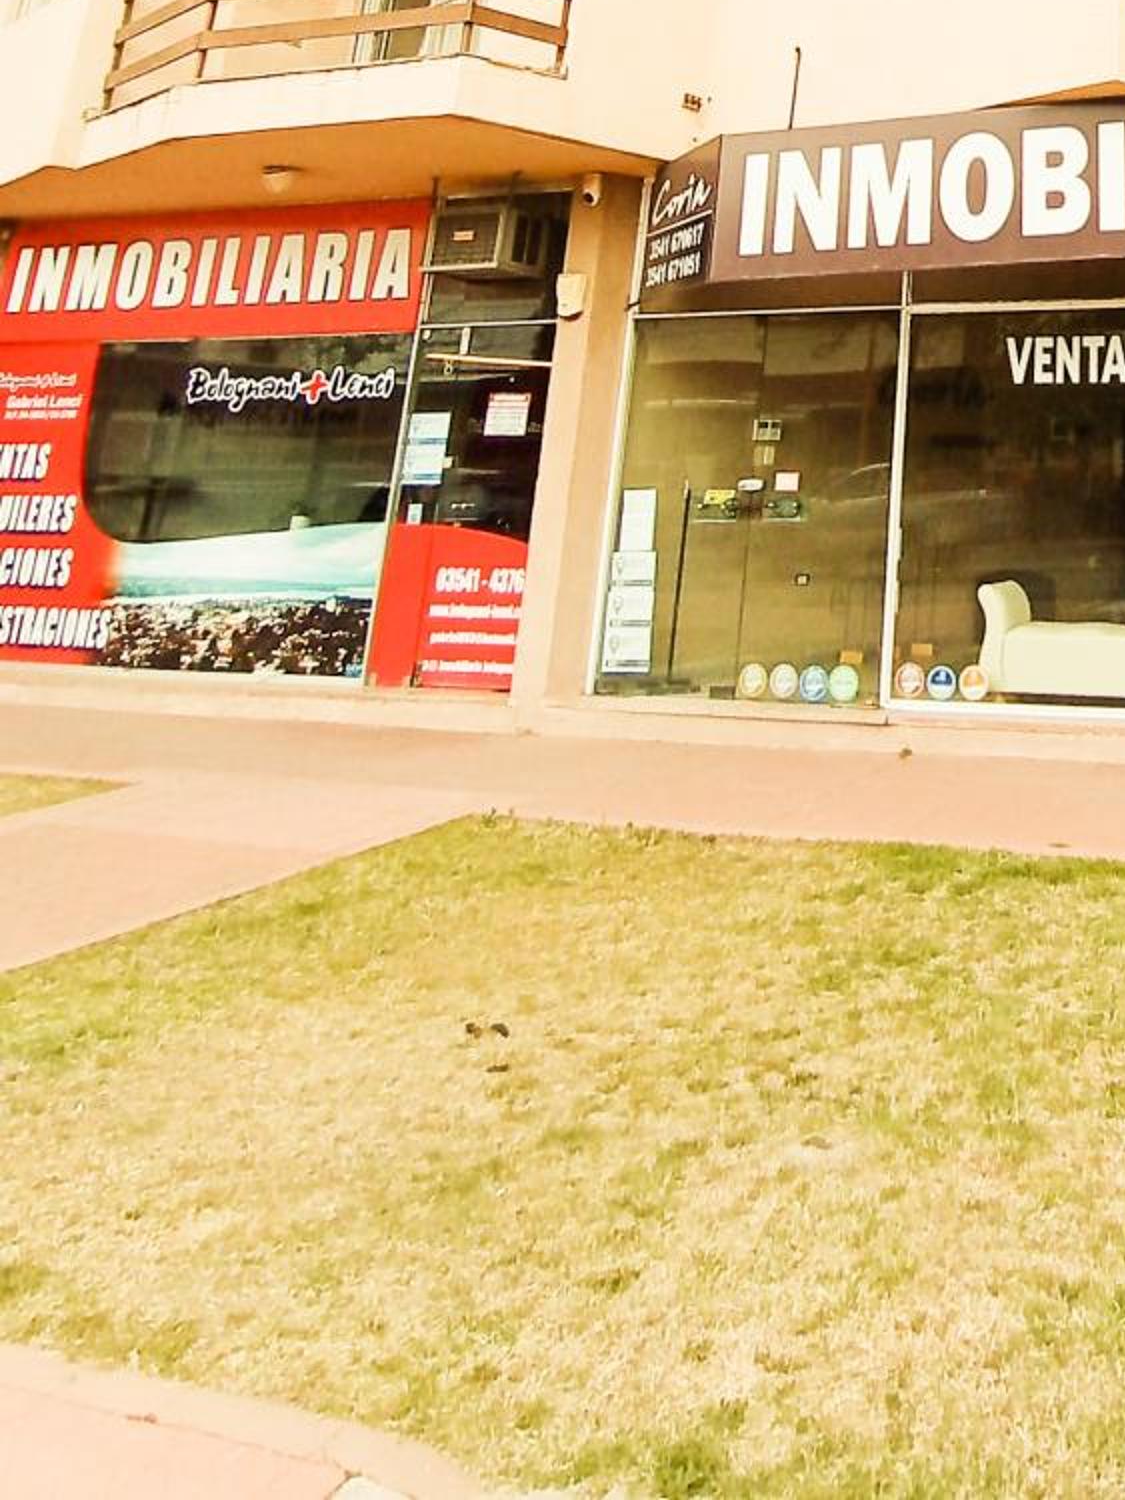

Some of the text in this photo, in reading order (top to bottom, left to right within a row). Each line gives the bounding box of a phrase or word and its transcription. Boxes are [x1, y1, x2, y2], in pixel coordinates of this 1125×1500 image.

[6, 227, 413, 313] INMOBILIARIA
[0, 442, 52, 481] NTAS
[0, 605, 112, 650] STRACIONES
